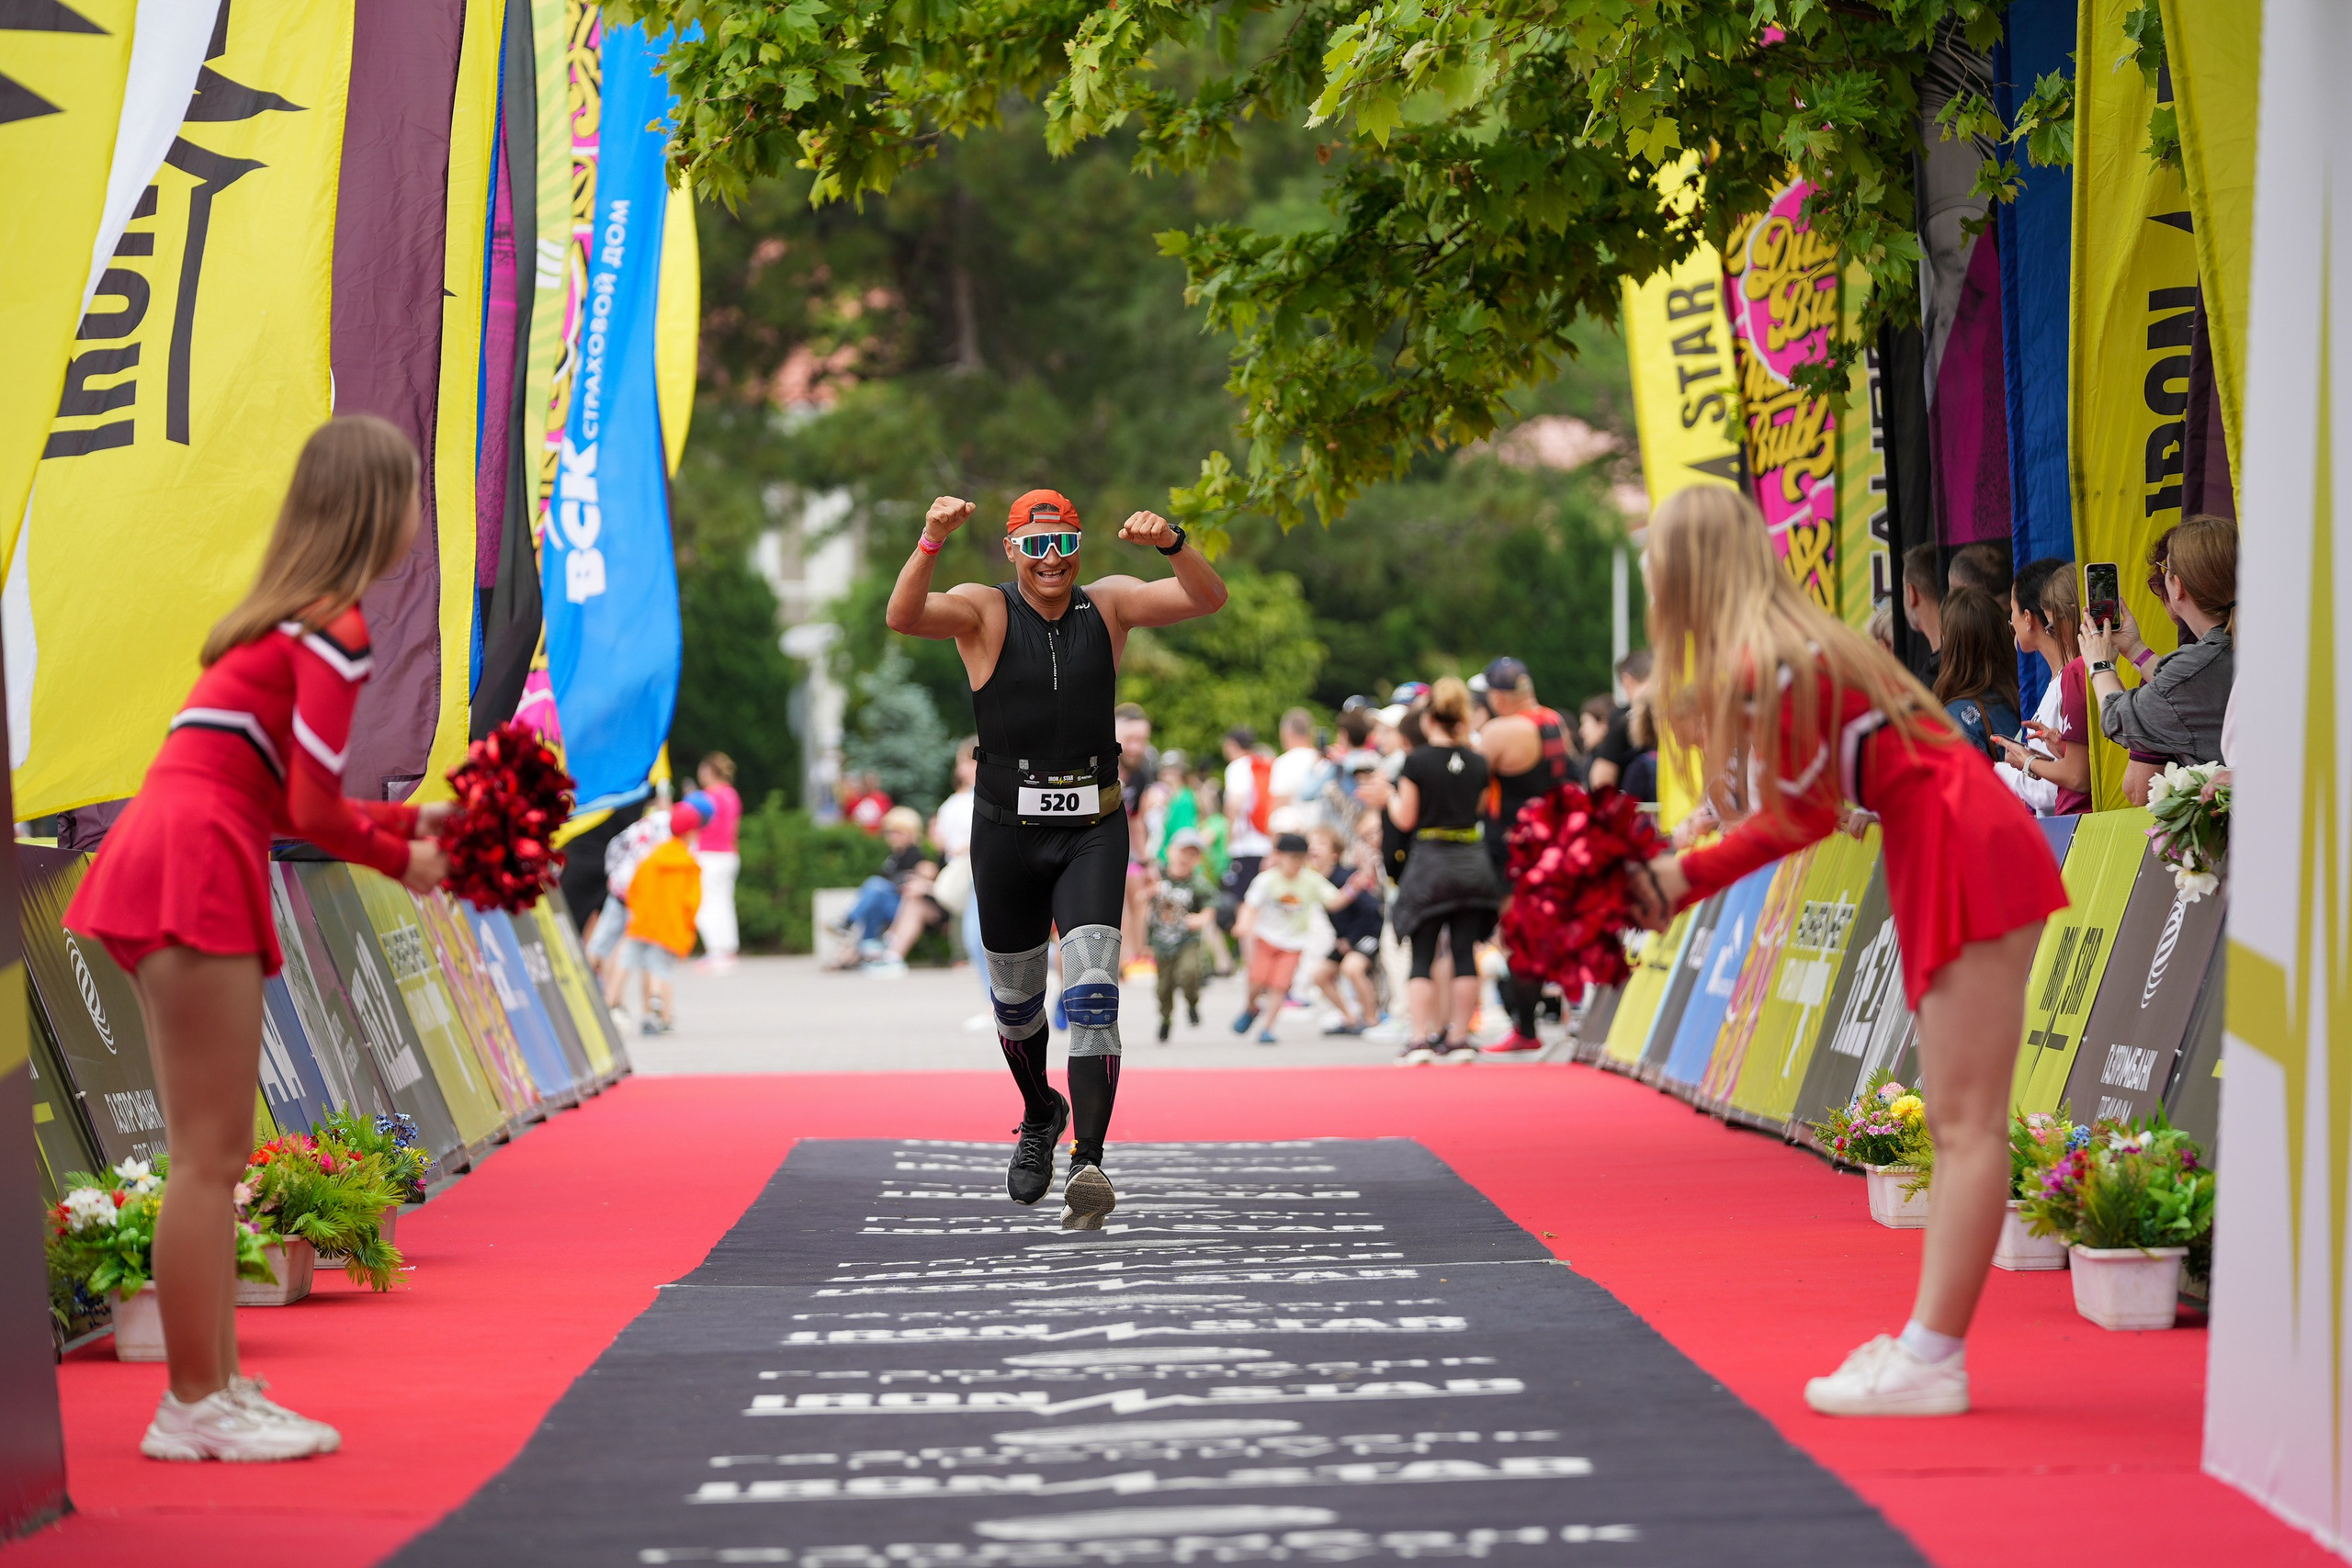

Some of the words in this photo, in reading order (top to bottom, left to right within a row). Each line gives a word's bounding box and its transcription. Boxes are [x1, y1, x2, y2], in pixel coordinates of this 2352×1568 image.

[601, 199, 631, 269] ДОМ
[582, 272, 617, 441] СТРАХОВОЙ
[1668, 279, 1727, 431] STAR
[560, 435, 606, 604] ВСК
[1040, 793, 1080, 812] 520
[2060, 926, 2104, 1015] STAR
[104, 1089, 165, 1134] ГАЗПРОМБАНК
[1170, 1252, 1405, 1266] STAR
[1172, 1269, 1419, 1281] STAR
[788, 1324, 1049, 1341] IRON
[1191, 1315, 1468, 1330] STAR
[751, 1391, 1049, 1409] IRON
[1208, 1377, 1525, 1397] STAR
